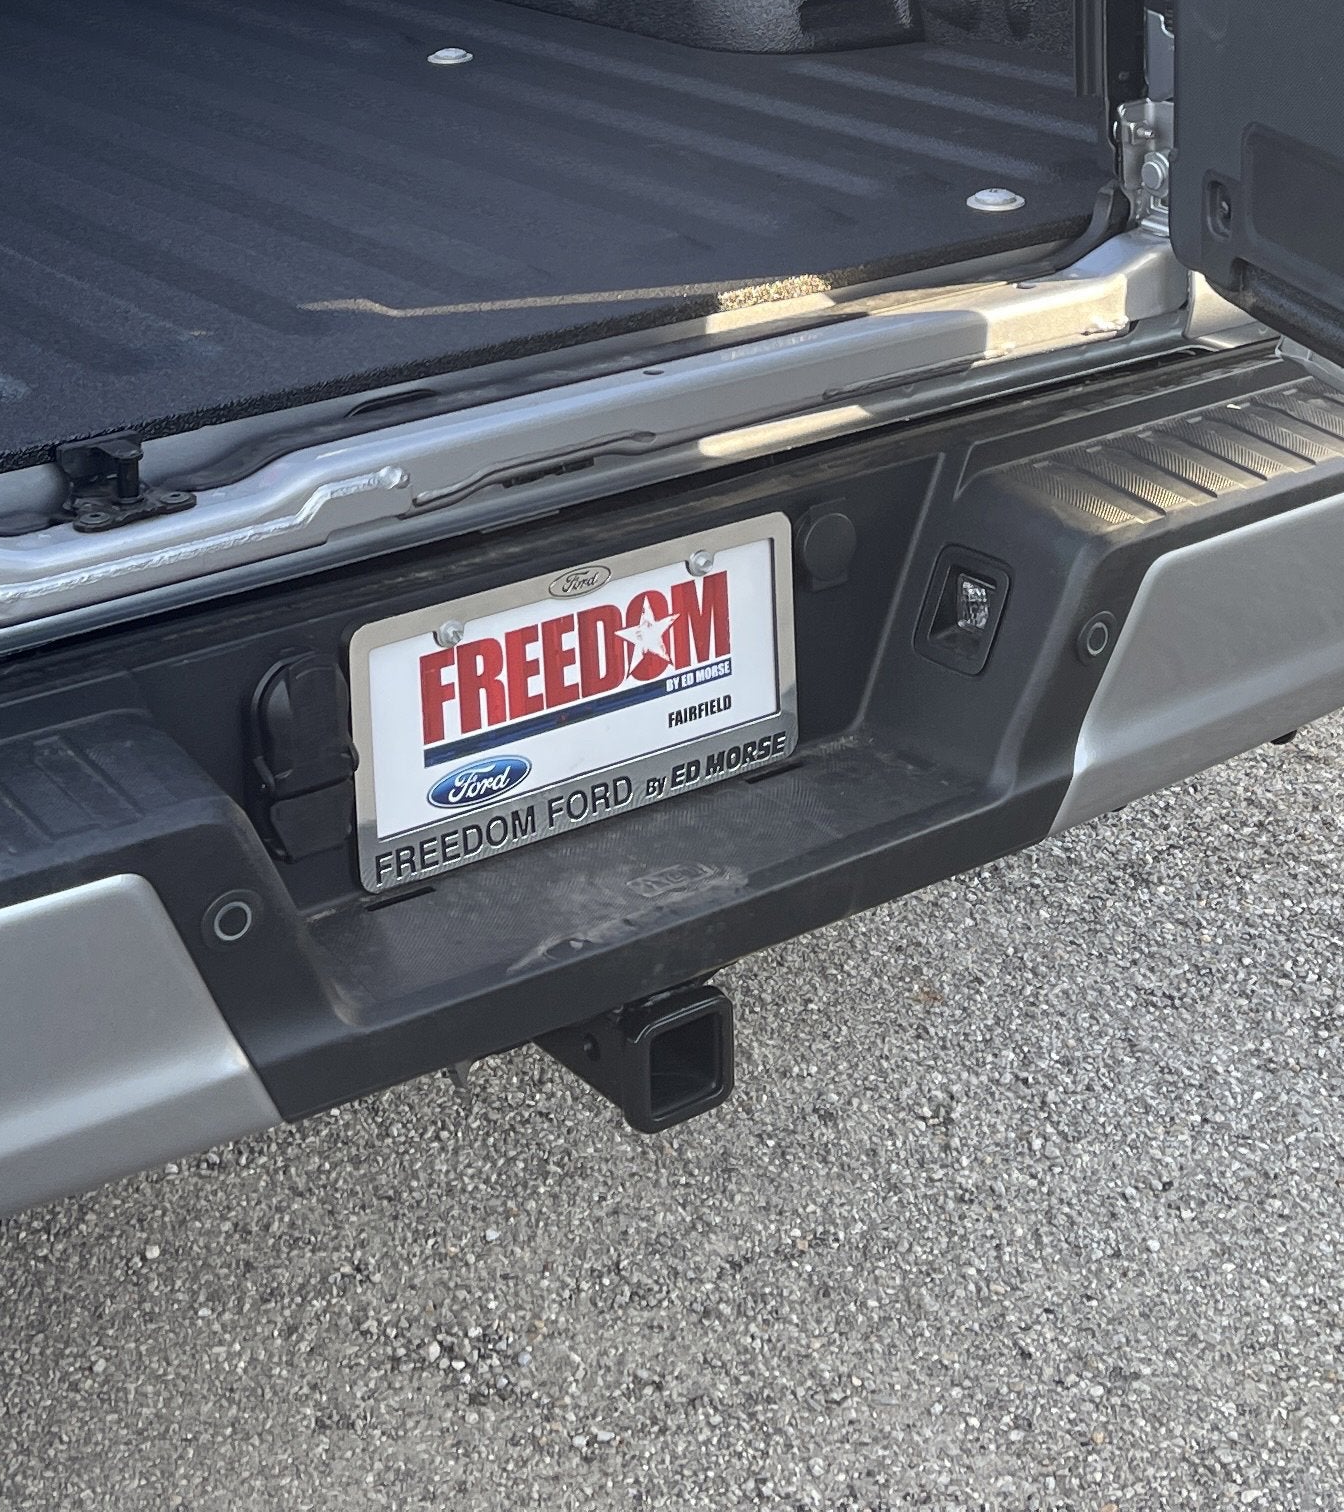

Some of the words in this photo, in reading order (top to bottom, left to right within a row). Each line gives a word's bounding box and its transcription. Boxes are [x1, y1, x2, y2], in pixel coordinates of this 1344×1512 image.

[562, 569, 599, 593] Ford
[419, 570, 732, 745] FREEDOM
[665, 677, 680, 693] BY
[681, 672, 695, 688] ED
[695, 662, 731, 685] MORSE
[668, 694, 732, 728] FAIRFIELD
[448, 766, 512, 804] Ford
[374, 804, 537, 887] FREEDOM
[548, 775, 634, 830] FORD
[671, 759, 701, 790] ED
[705, 731, 787, 777] MORSE
